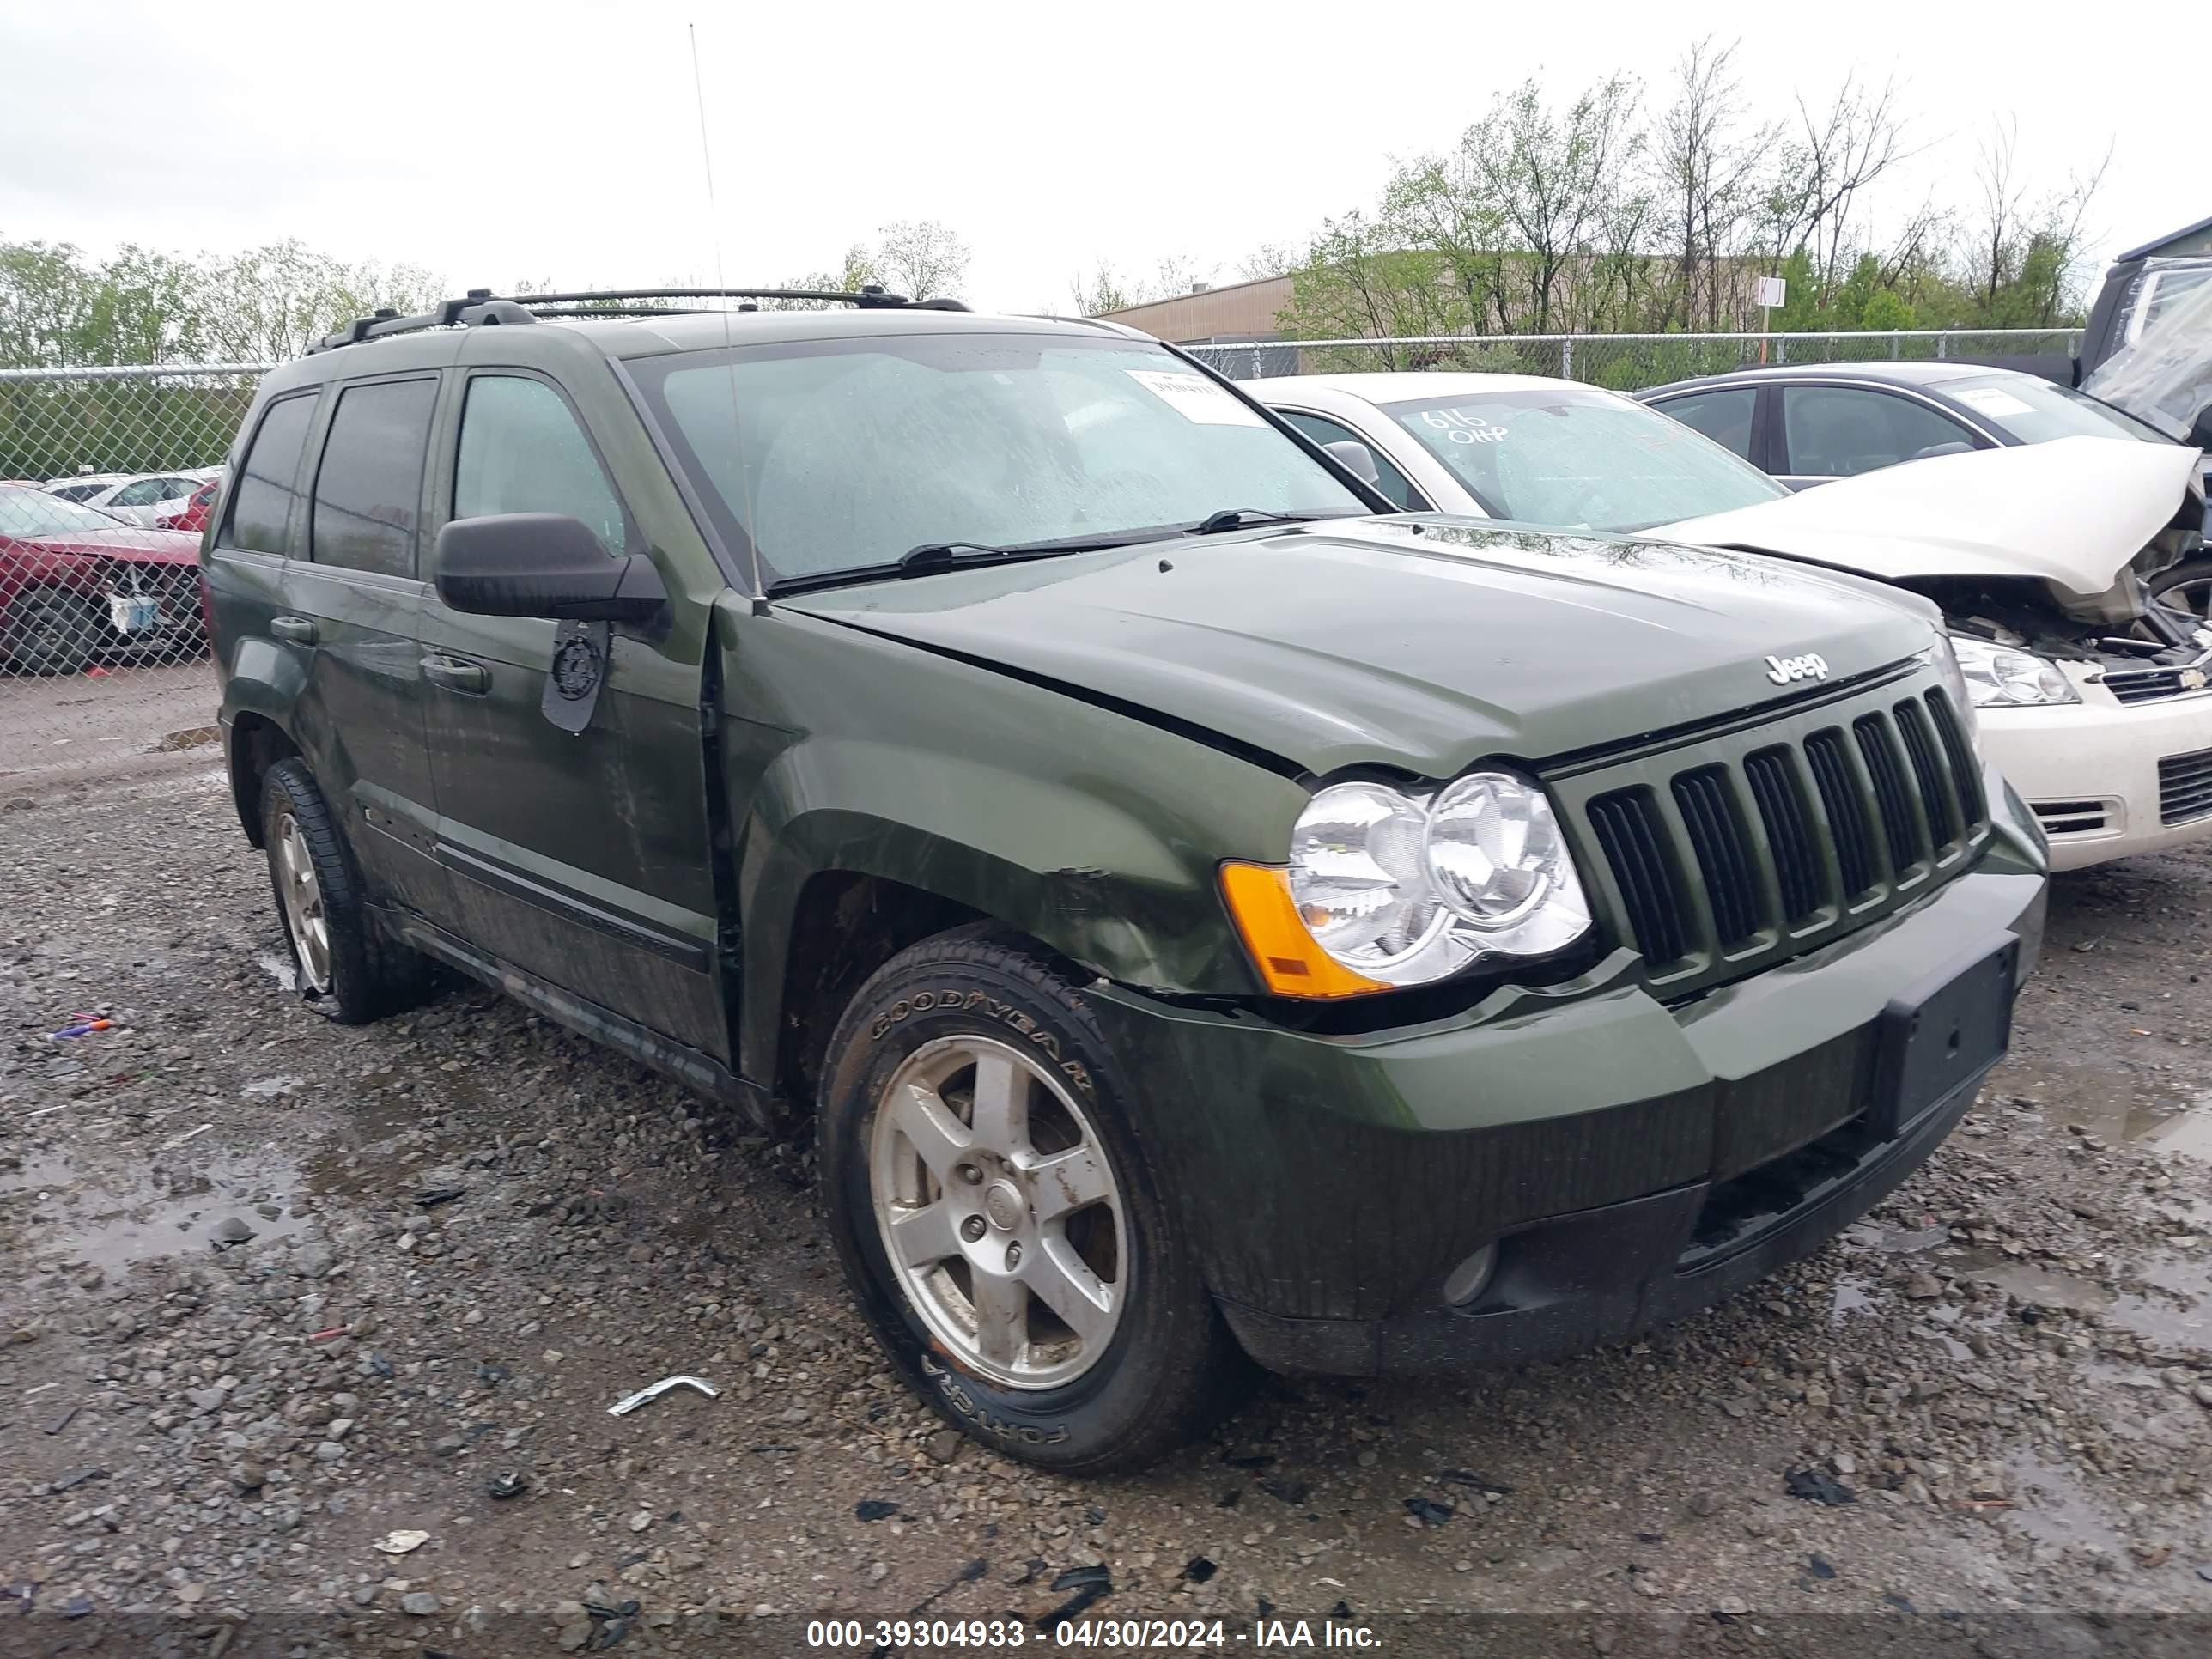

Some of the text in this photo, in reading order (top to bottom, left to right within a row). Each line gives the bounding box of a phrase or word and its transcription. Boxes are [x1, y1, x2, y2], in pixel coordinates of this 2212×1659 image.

[1765, 653, 1829, 685] Jeep
[872, 988, 1092, 1091] GOODYEAR
[921, 1354, 1071, 1444] FORTERA
